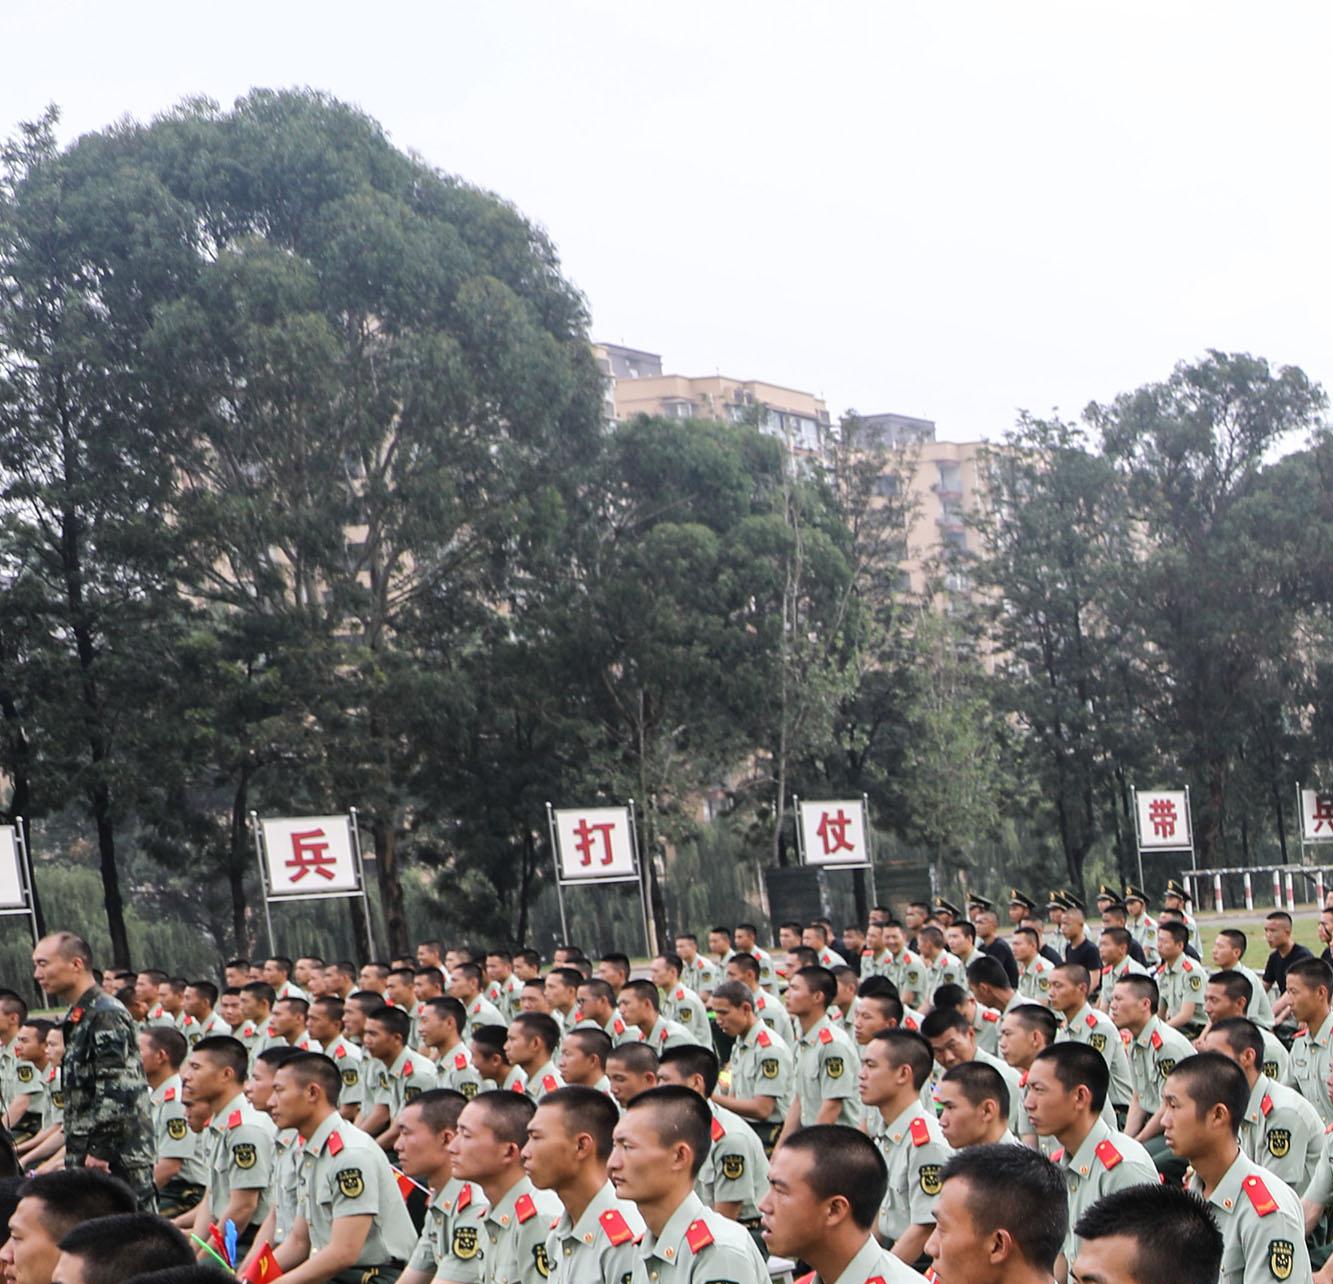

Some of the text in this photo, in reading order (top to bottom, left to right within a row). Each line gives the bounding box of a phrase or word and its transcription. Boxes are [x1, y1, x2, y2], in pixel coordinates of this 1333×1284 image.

[284, 827, 338, 883] 兵
[573, 818, 617, 867] 打
[816, 809, 855, 855] 仗
[1149, 799, 1178, 838] 带
